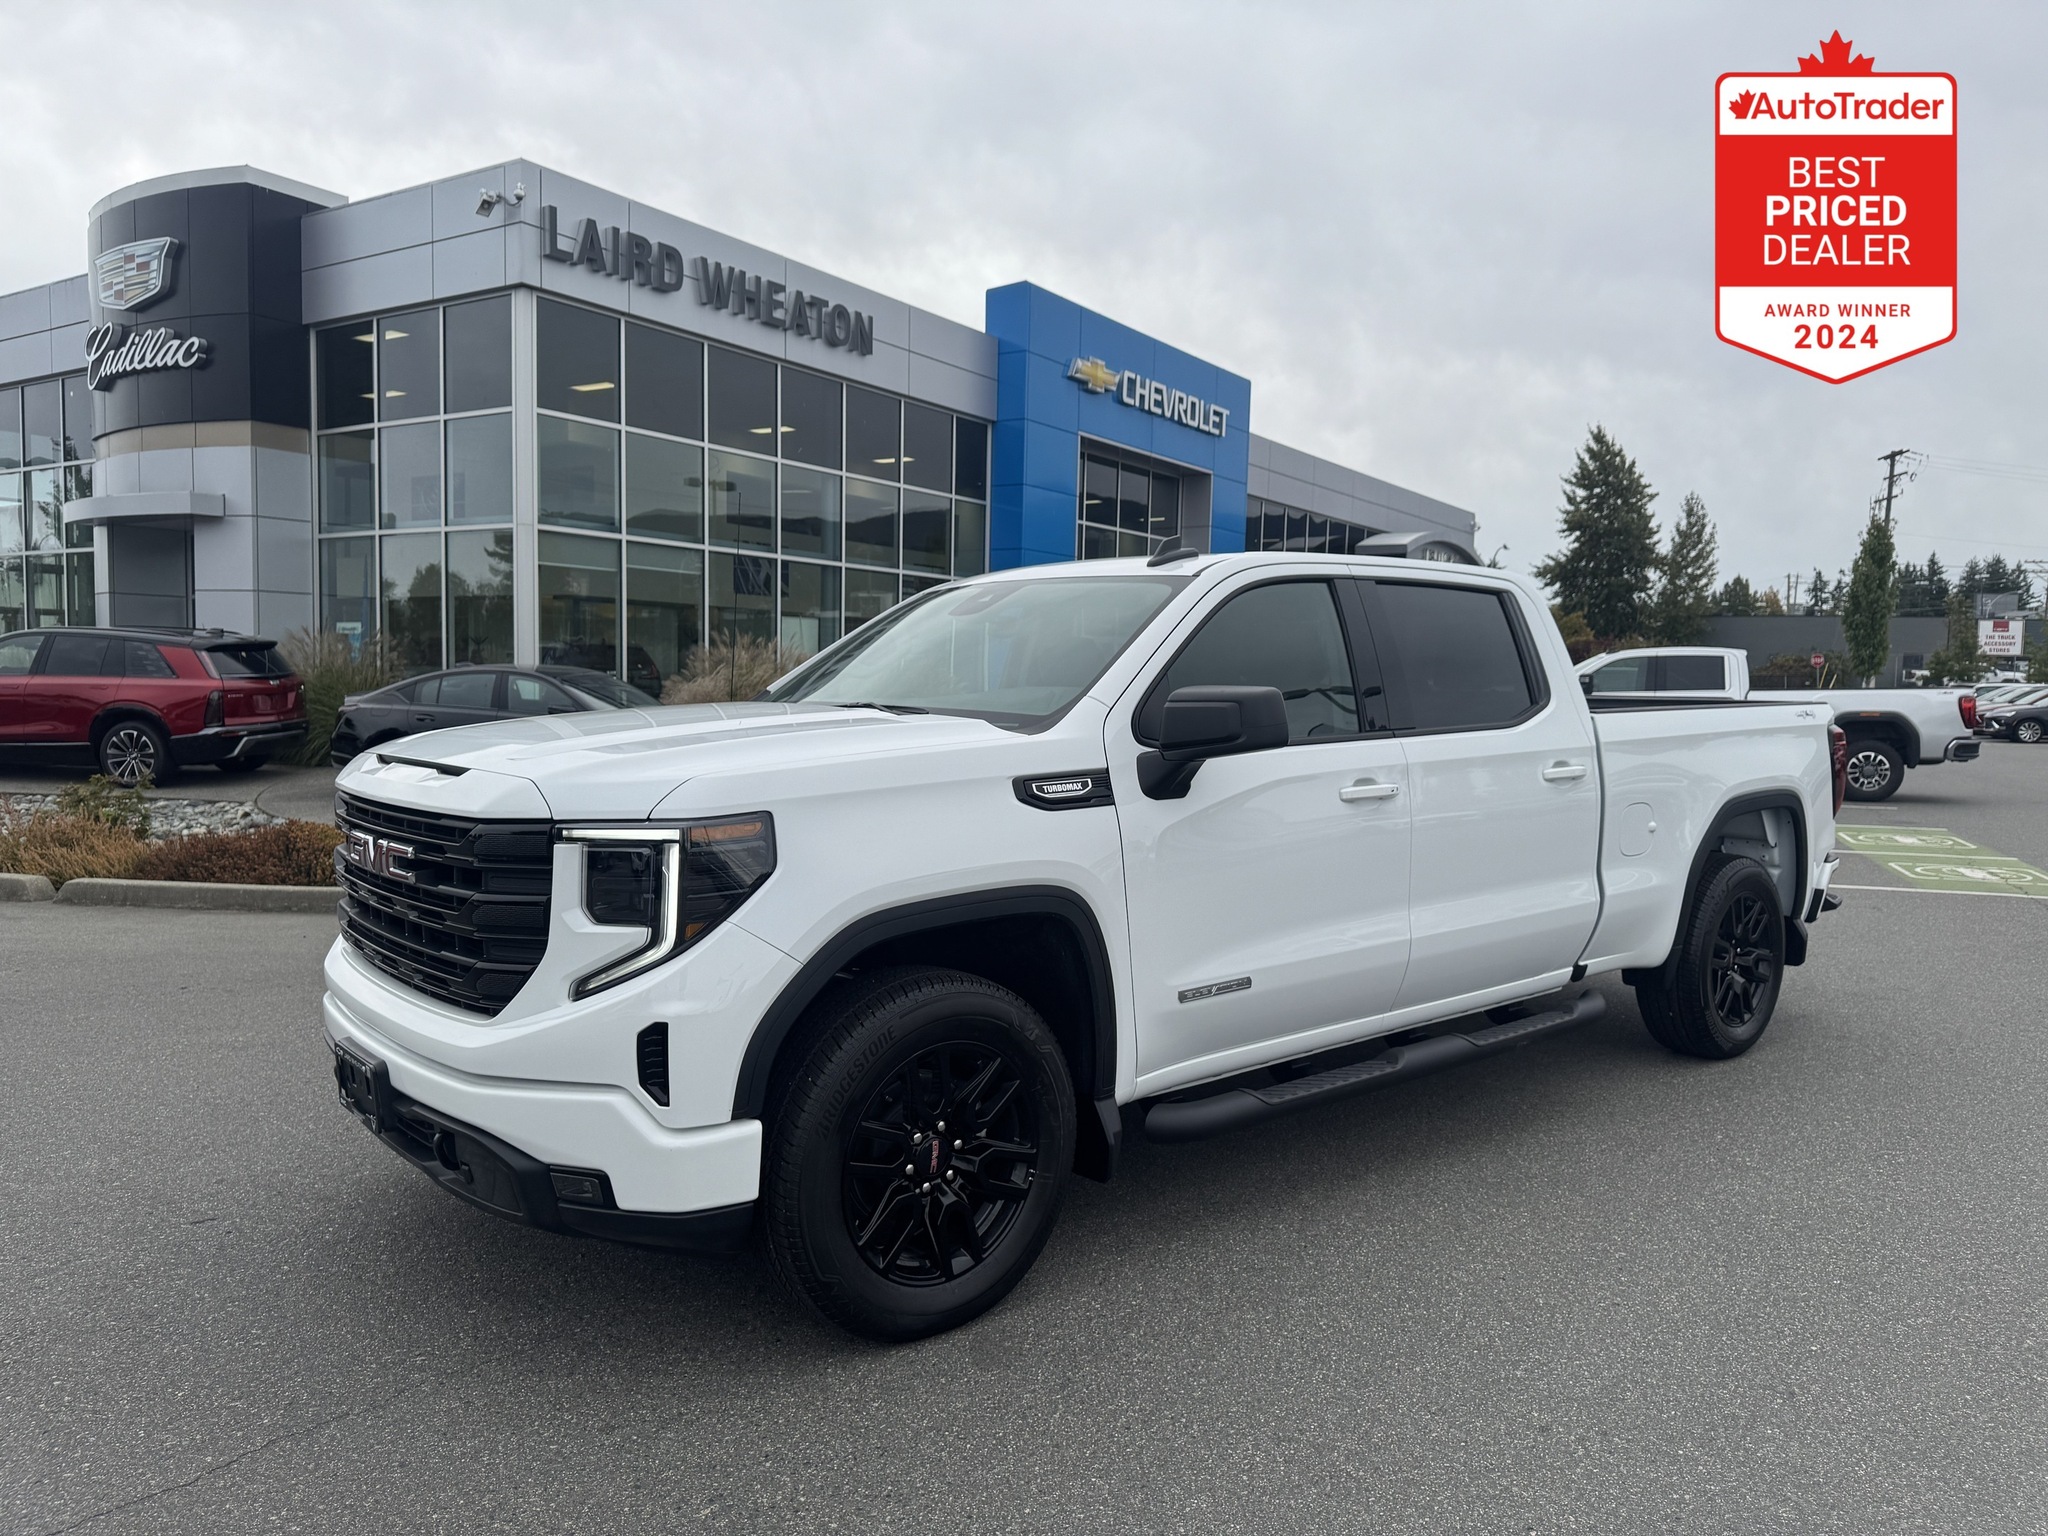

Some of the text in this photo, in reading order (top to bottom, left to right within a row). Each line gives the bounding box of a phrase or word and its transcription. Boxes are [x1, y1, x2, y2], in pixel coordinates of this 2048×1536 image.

[542, 204, 874, 356] LAIRD WHEATON
[84, 320, 206, 391] Cadillac
[1121, 369, 1230, 438] CHEVROLET
[1042, 782, 1083, 793] TURBOMAX
[348, 830, 416, 884] GMC
[930, 1140, 939, 1174] GMC
